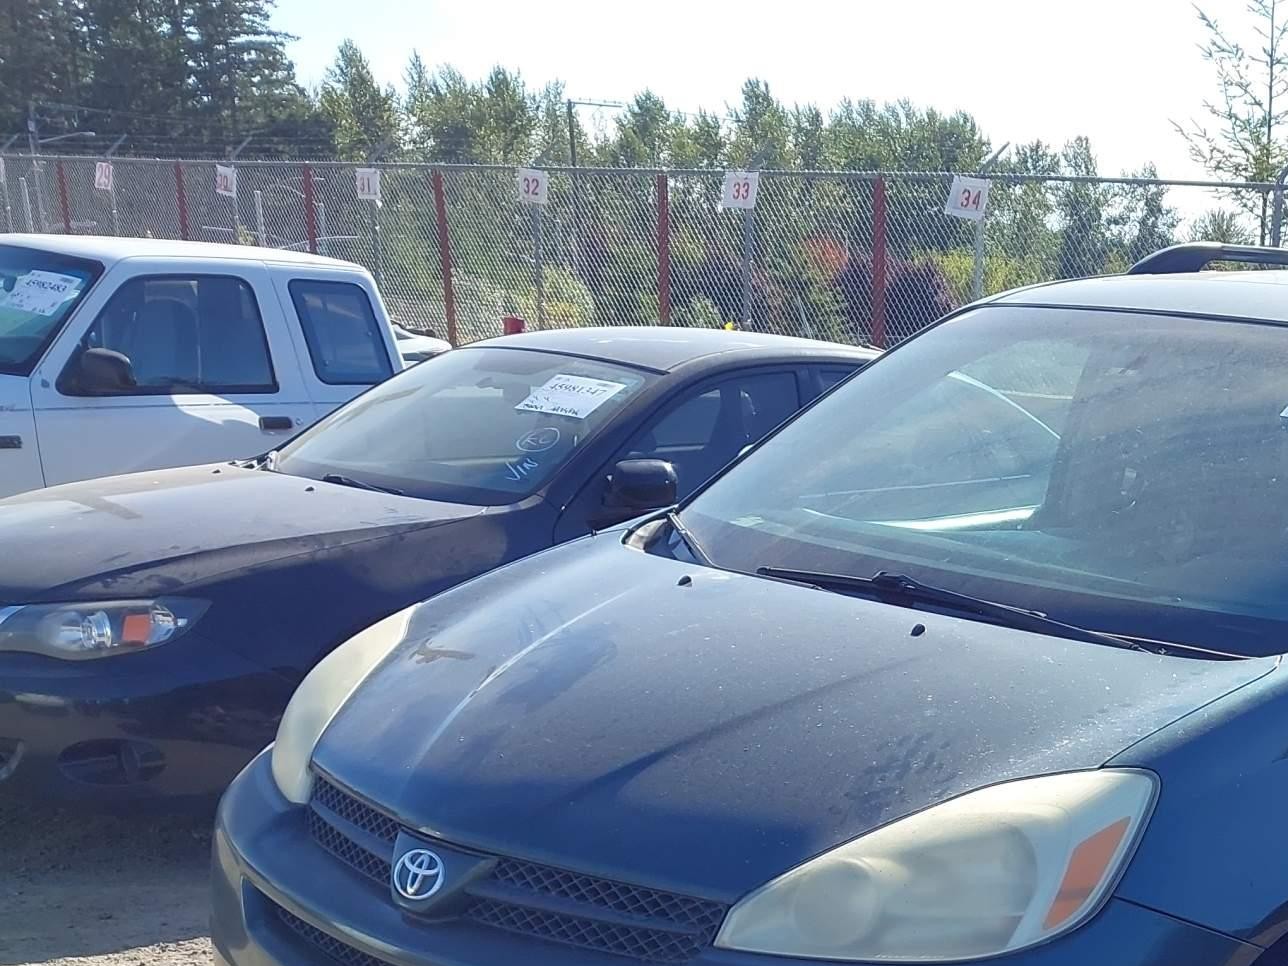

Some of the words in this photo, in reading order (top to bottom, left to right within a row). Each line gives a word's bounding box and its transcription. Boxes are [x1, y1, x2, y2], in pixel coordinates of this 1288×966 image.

[522, 177, 540, 196] 32
[732, 181, 750, 200] 33
[960, 188, 982, 210] 34
[504, 457, 539, 481] VIN
